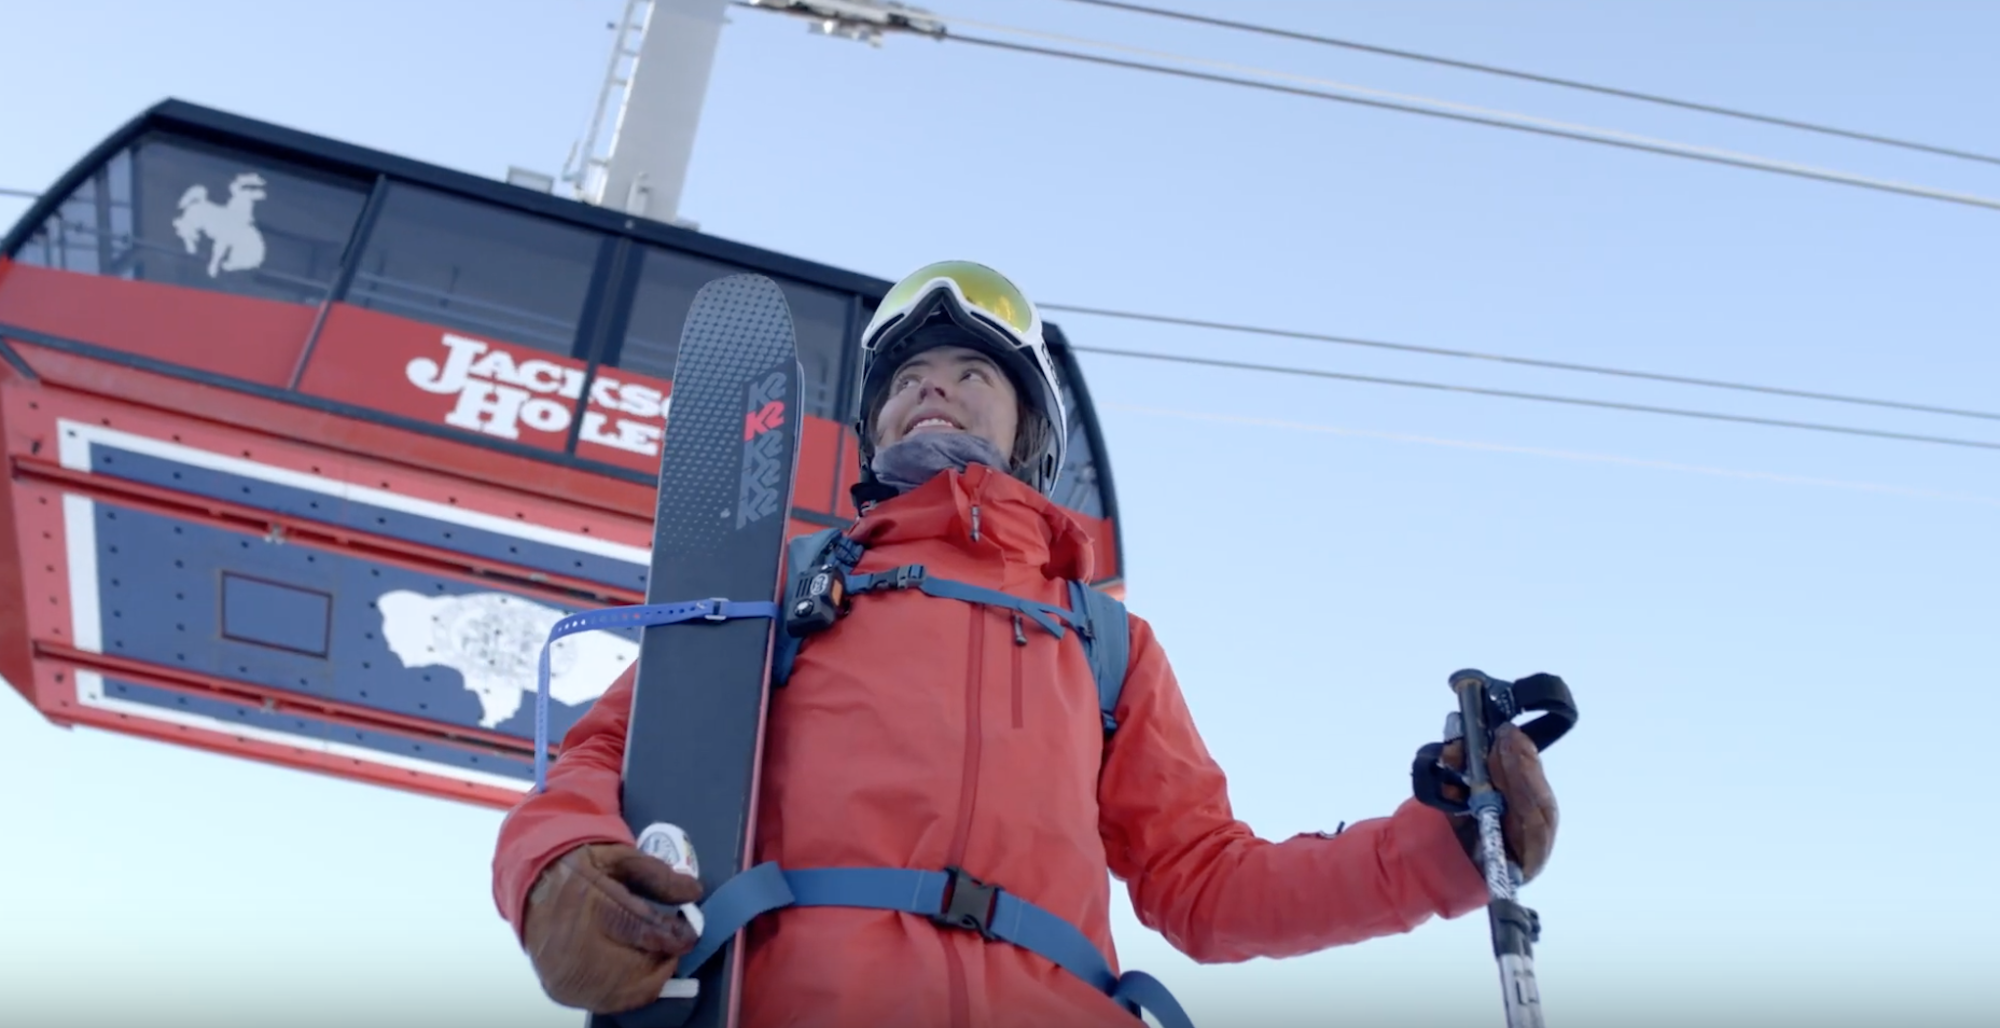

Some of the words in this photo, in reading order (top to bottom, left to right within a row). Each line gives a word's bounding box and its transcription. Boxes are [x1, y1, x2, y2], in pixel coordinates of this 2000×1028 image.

[748, 371, 787, 411] K2
[445, 377, 661, 456] HOLE
[744, 400, 785, 442] K2
[743, 430, 783, 470] K2
[741, 458, 781, 499] K2
[736, 487, 778, 530] K2
